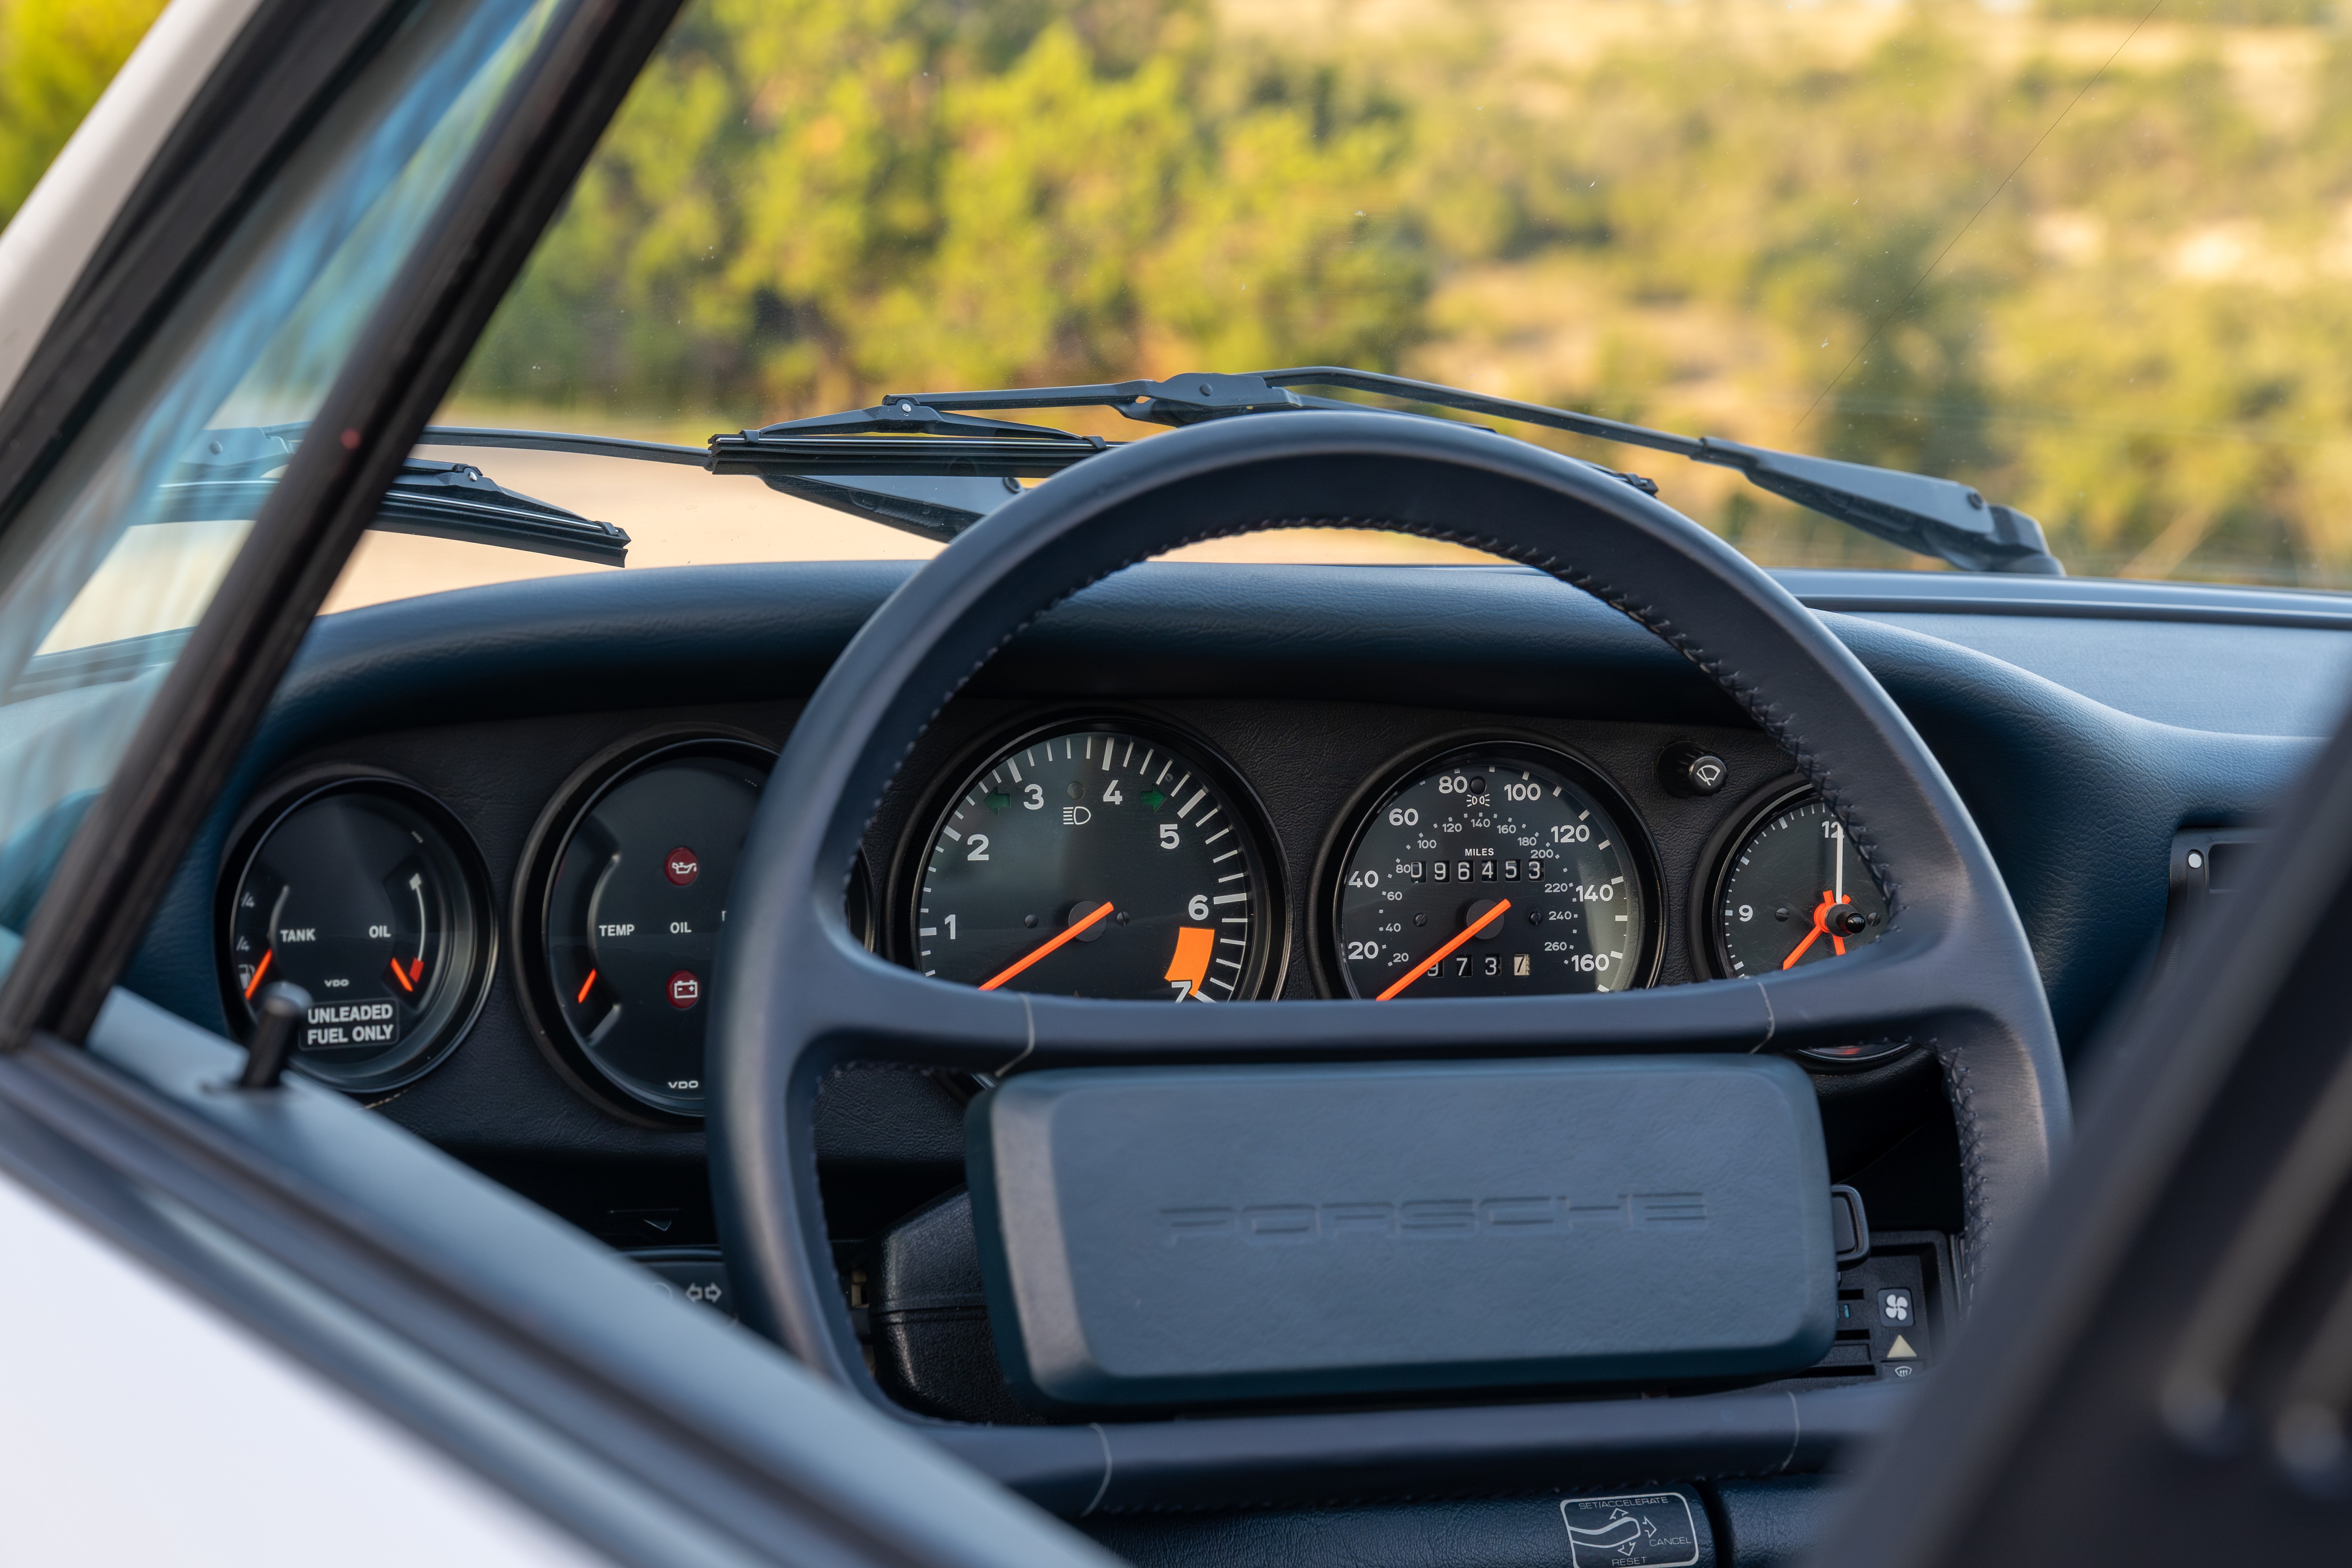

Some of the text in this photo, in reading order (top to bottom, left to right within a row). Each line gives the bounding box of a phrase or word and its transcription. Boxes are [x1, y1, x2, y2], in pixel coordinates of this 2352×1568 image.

[1439, 776, 1468, 794] 80
[1023, 784, 1044, 810] 3
[1103, 779, 1123, 805] 4
[1504, 783, 1541, 801] 100
[1389, 808, 1419, 826] 60
[1471, 818, 1490, 828] 140
[1442, 823, 1462, 832] 120
[1497, 824, 1516, 834] 160
[1551, 824, 1590, 843] 120
[1160, 824, 1180, 850] 5
[1517, 837, 1537, 847] 180
[967, 834, 989, 861] 2
[1417, 839, 1437, 849] 100
[1465, 848, 1494, 856] MILES
[1530, 849, 1554, 859] 200
[1396, 864, 1411, 873] 80
[1348, 870, 1379, 888] 40
[1544, 883, 1568, 893] 220
[1576, 884, 1613, 902] 140
[1387, 891, 1403, 901] 60
[1188, 895, 1209, 921] 6
[1739, 904, 1753, 922] 9
[1549, 911, 1572, 921] 240
[369, 925, 391, 938] OIL
[598, 924, 635, 937] TEMP
[670, 922, 692, 934] OIL
[944, 914, 956, 939] 1
[1385, 923, 1401, 932] 40
[280, 928, 316, 942] TANK
[1348, 941, 1379, 960] 20
[1544, 942, 1567, 951] 260
[1393, 953, 1409, 963] 20
[1571, 954, 1610, 972] 160
[324, 979, 349, 987] VDO
[1172, 981, 1191, 1003] 7
[308, 1004, 393, 1024] UNLEADED
[308, 1024, 393, 1045] FUEL ONLY
[668, 1080, 699, 1089] VDO
[1159, 1191, 1708, 1247] PORSCHE
[1649, 1537, 1692, 1547] CANCEL
[1612, 1556, 1647, 1566] RESET
